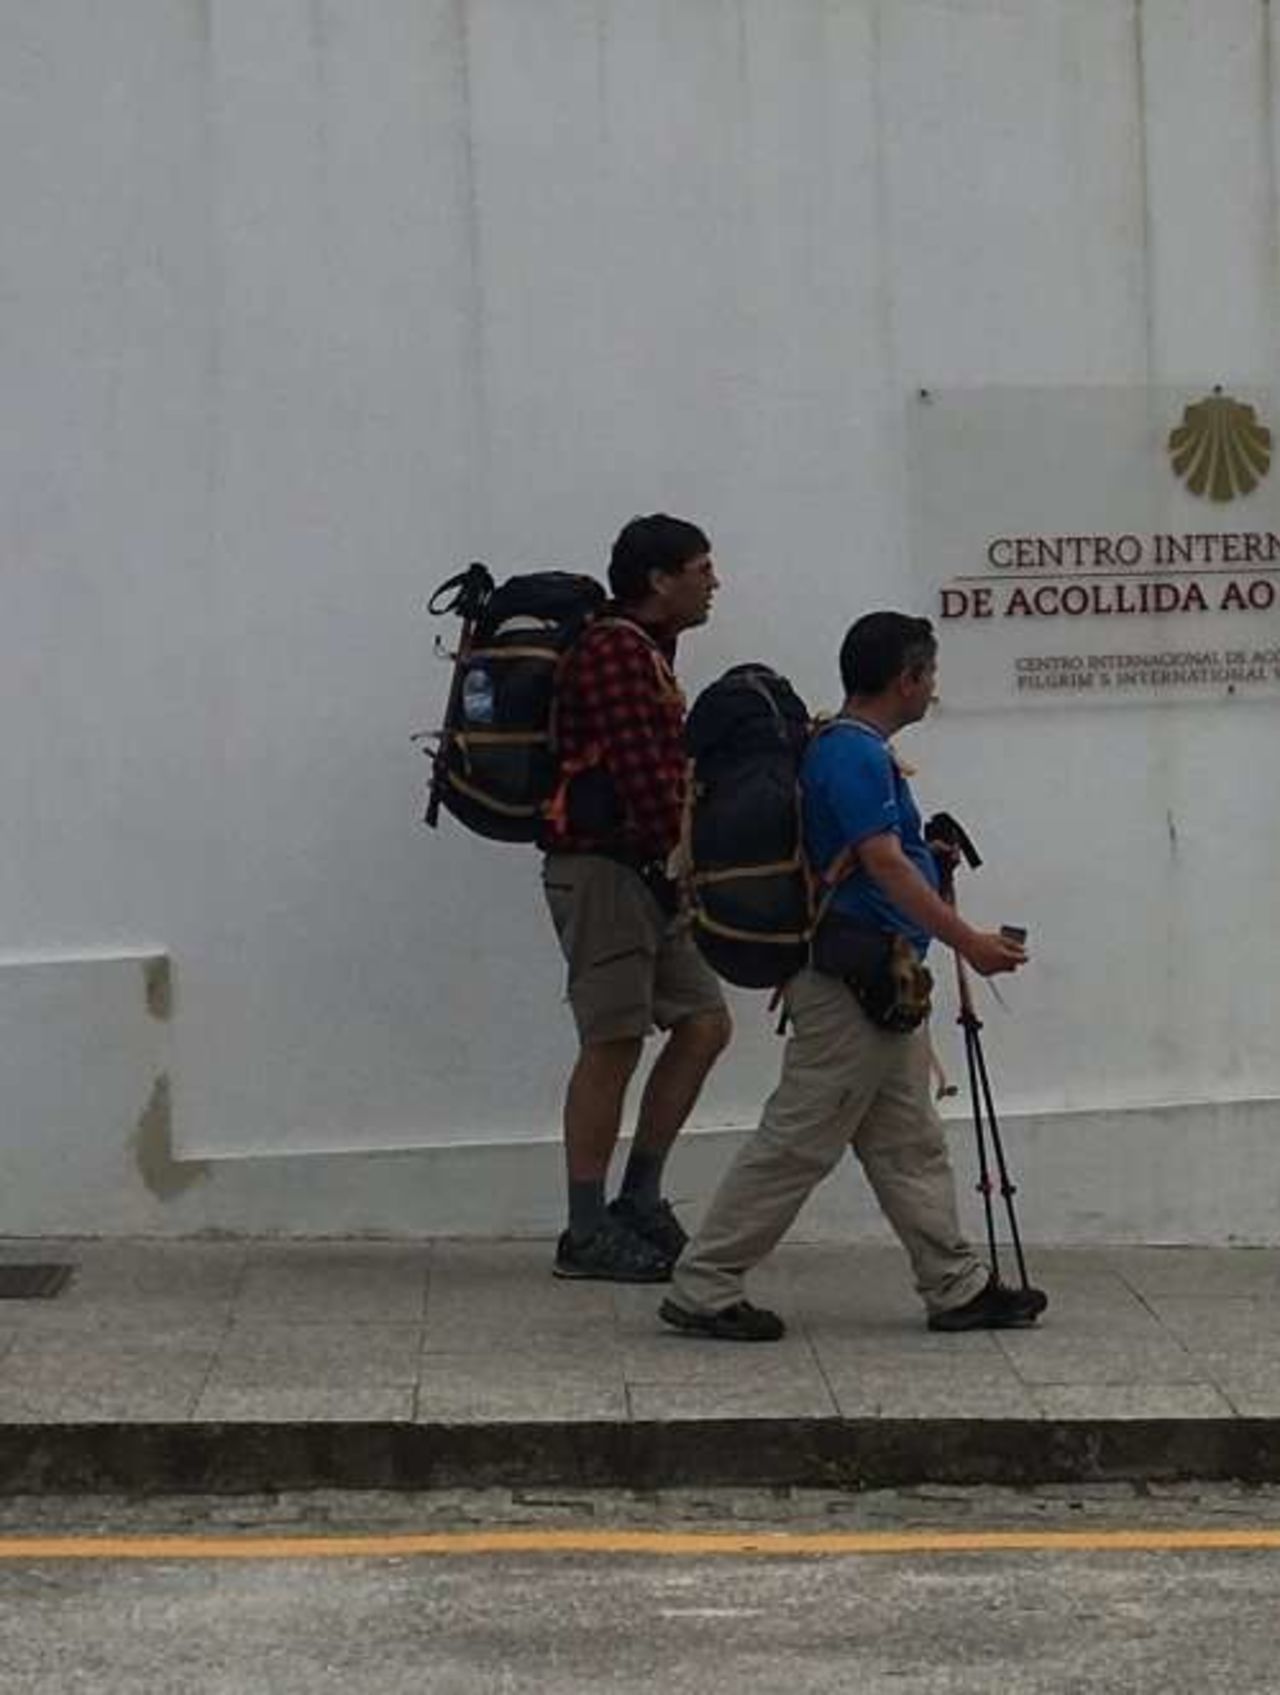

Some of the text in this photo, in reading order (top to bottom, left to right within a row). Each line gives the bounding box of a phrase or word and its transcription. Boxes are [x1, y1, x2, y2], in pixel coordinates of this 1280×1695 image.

[988, 535, 1143, 568] CENTRO
[940, 589, 993, 618] DE
[1004, 581, 1208, 615] ACOLLIDA
[1220, 580, 1275, 610] AO
[1015, 656, 1084, 671] CENTRO
